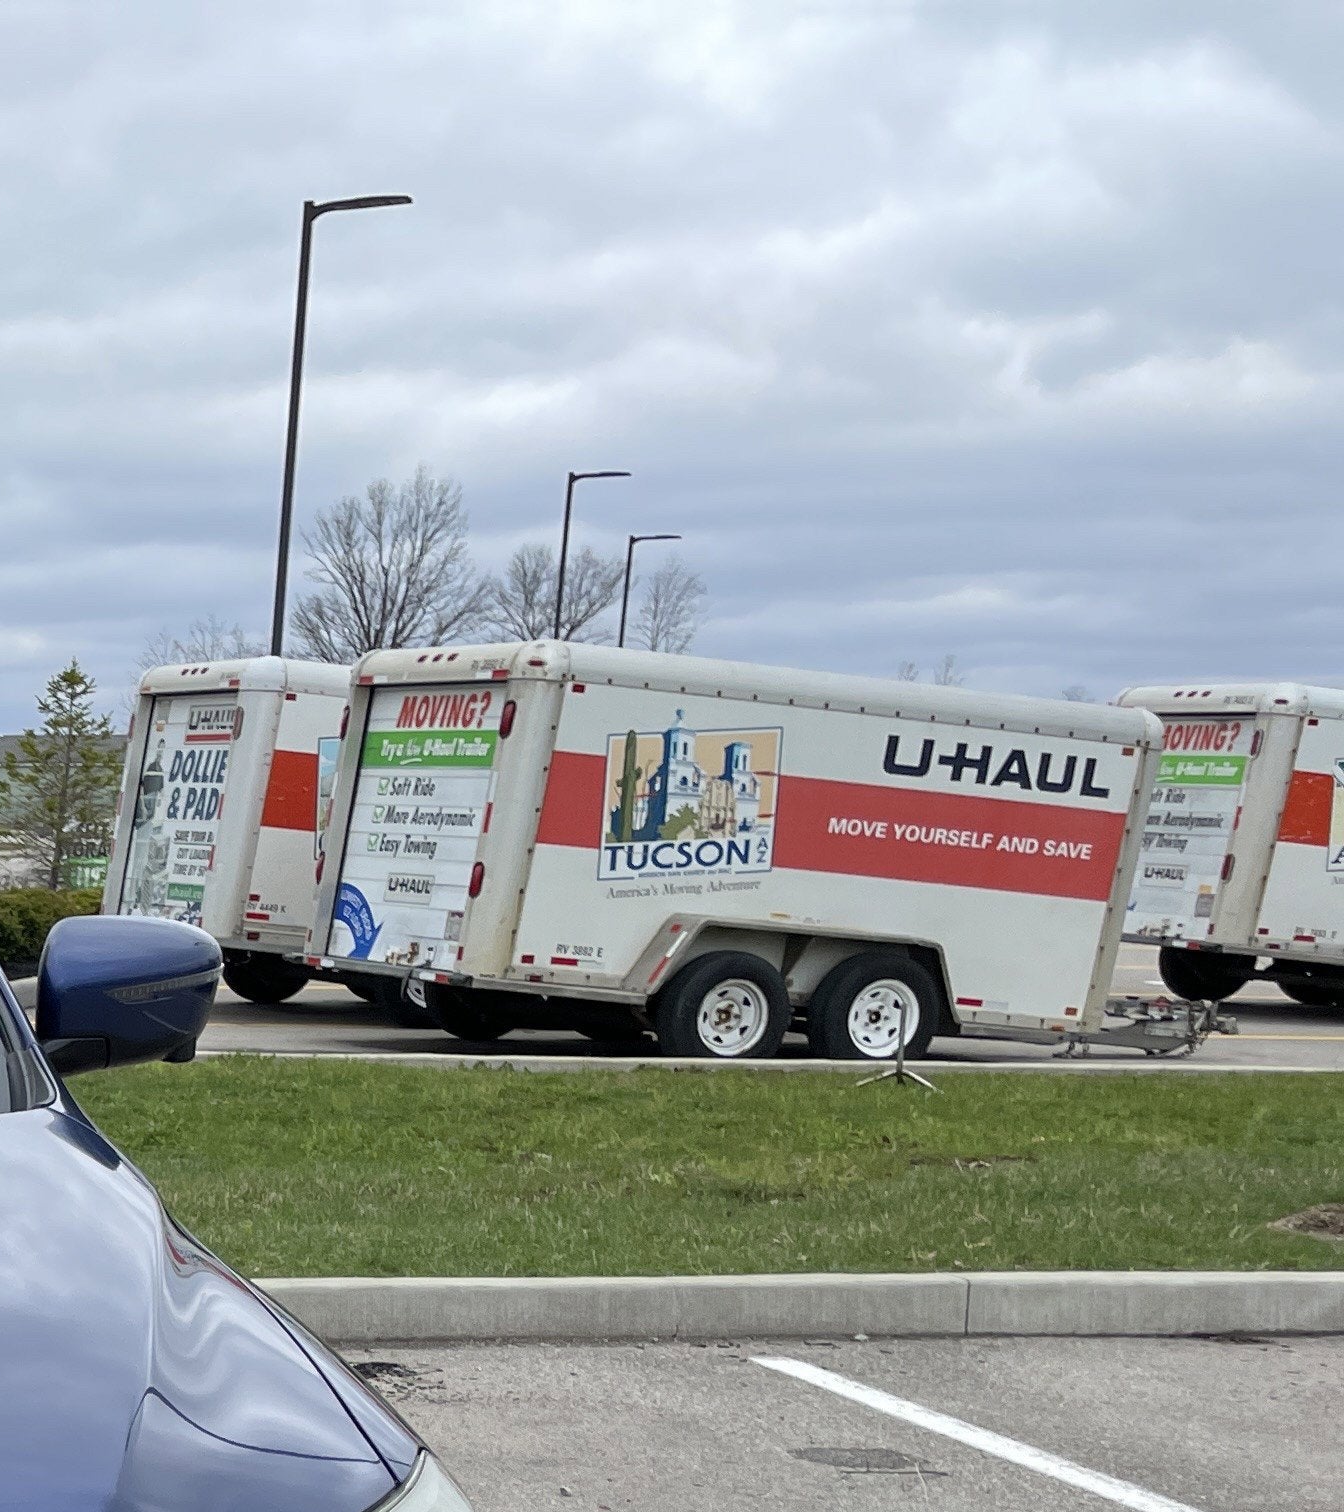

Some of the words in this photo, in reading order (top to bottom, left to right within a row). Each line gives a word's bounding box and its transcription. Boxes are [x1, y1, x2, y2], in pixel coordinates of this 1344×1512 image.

[396, 690, 492, 729] MOVING?
[456, 737, 491, 757] Trailer
[882, 734, 1111, 799] U-HAUL
[389, 777, 412, 797] Soft
[412, 777, 436, 797] Ride
[167, 786, 180, 820] &
[383, 805, 410, 825] More
[411, 805, 476, 831] Aerodynamic
[379, 833, 401, 859] Easy
[403, 834, 438, 860] Towing
[827, 816, 889, 839] MOVE
[893, 823, 994, 850] YOURSELF
[996, 835, 1039, 855] AND
[1043, 839, 1094, 861] SAVE
[603, 839, 751, 872] TUCSON
[387, 876, 431, 895] U-HAUL
[1143, 866, 1185, 881] U-HAUL
